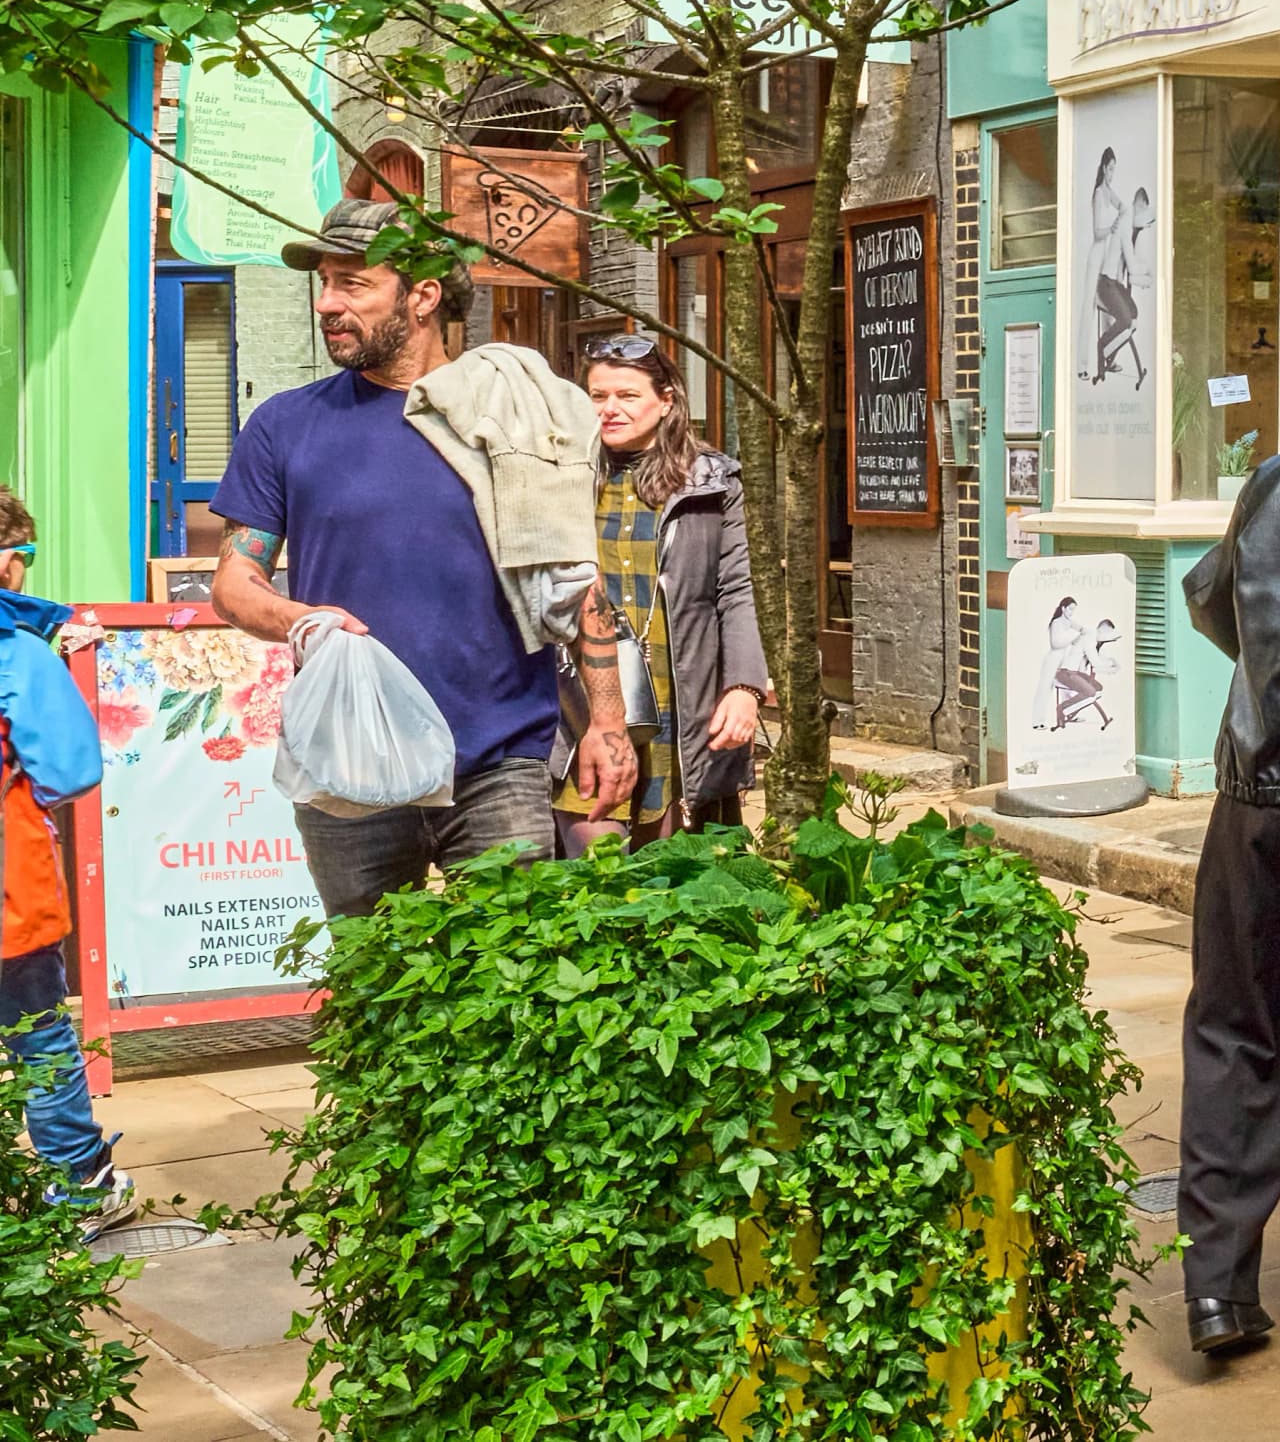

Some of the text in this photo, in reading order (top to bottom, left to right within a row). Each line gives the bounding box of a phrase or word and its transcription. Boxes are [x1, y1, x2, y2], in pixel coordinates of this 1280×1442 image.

[194, 91, 220, 105] Hair
[194, 105, 213, 115] Hair
[192, 156, 210, 166] Hair
[228, 184, 276, 201] assage
[856, 229, 893, 273] WHAT
[880, 268, 918, 308] PERSON
[869, 338, 913, 384] PIZZA?
[857, 392, 866, 434] A
[160, 837, 310, 869] CHI NAIL
[200, 868, 284, 882] (FIRST FLOOR)
[163, 894, 321, 918] NAILS EXTENSIONS
[200, 914, 287, 933] NAILS ART
[188, 950, 278, 969] SPA PEDIC
